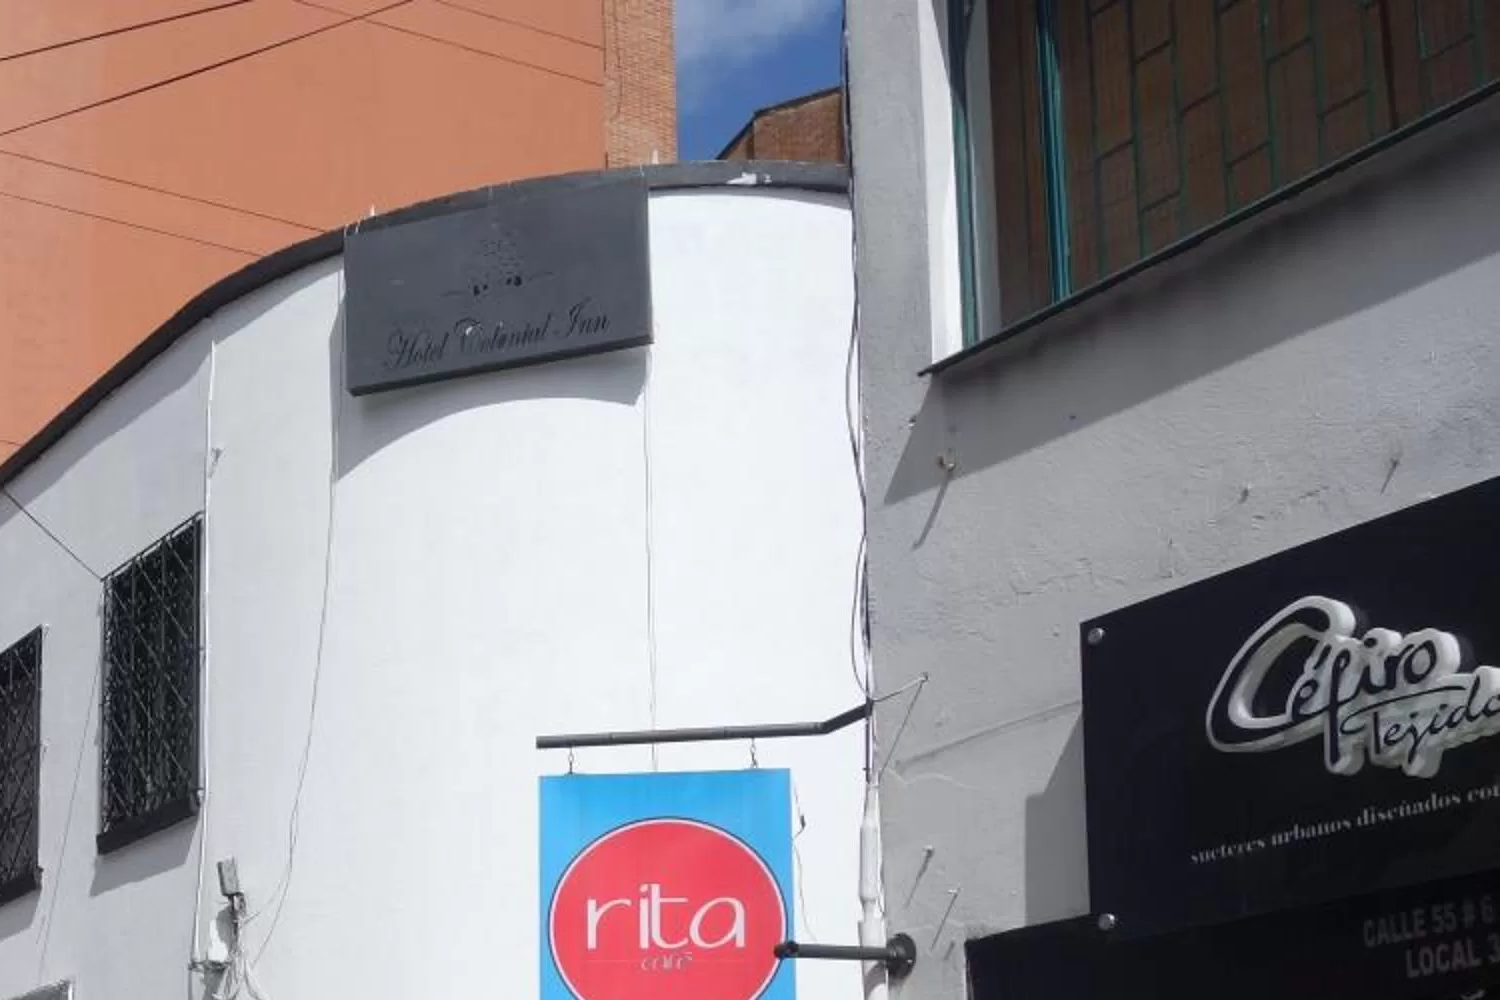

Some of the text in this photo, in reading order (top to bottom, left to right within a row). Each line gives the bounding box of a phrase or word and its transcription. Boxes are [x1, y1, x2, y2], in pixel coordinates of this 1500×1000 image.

[386, 328, 449, 369] Hotel
[556, 298, 610, 337] Inn
[1271, 818, 1352, 847] urbanos
[586, 883, 746, 950] rita
[1363, 907, 1428, 948] CALLE
[1431, 902, 1457, 934] 55
[1405, 936, 1483, 978] LOCAL
